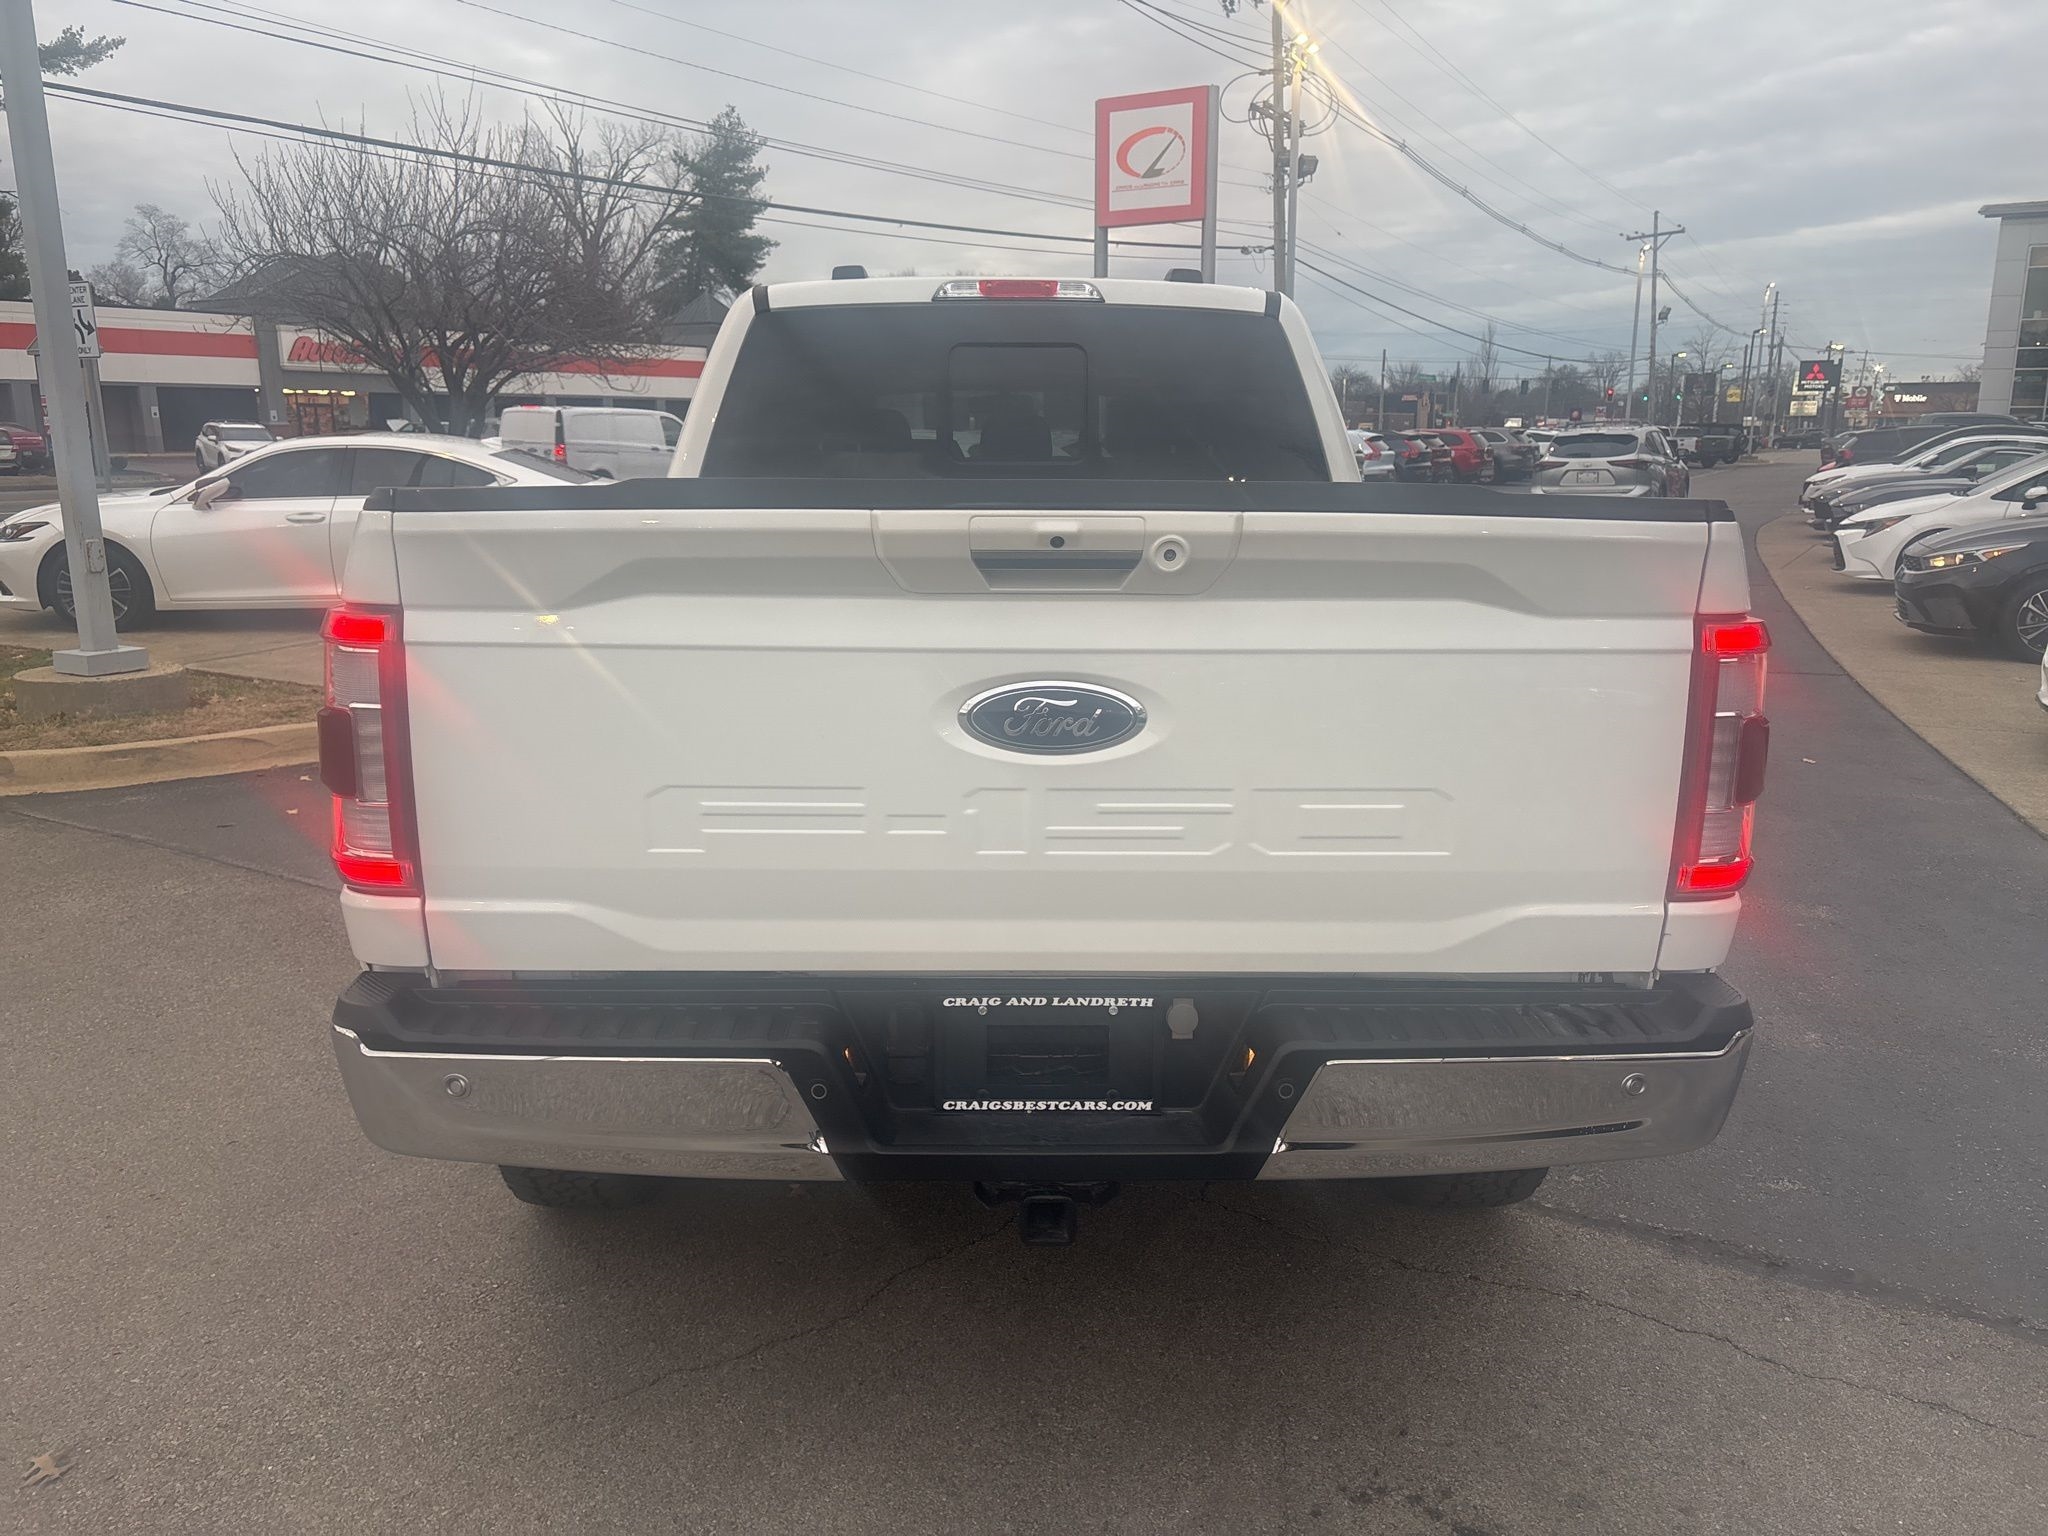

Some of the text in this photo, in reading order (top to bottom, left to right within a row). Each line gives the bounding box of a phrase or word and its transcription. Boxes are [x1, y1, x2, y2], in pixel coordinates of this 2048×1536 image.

[69, 286, 87, 295] ENTER
[77, 346, 92, 354] ONLY
[1902, 394, 1928, 403] Mobile
[1001, 696, 1103, 737] Ford
[645, 785, 1455, 856] F-150
[942, 996, 1155, 1009] CRAIG AND LANDRETH
[942, 1098, 1154, 1112] CRAIGSBESTCARS.COM
